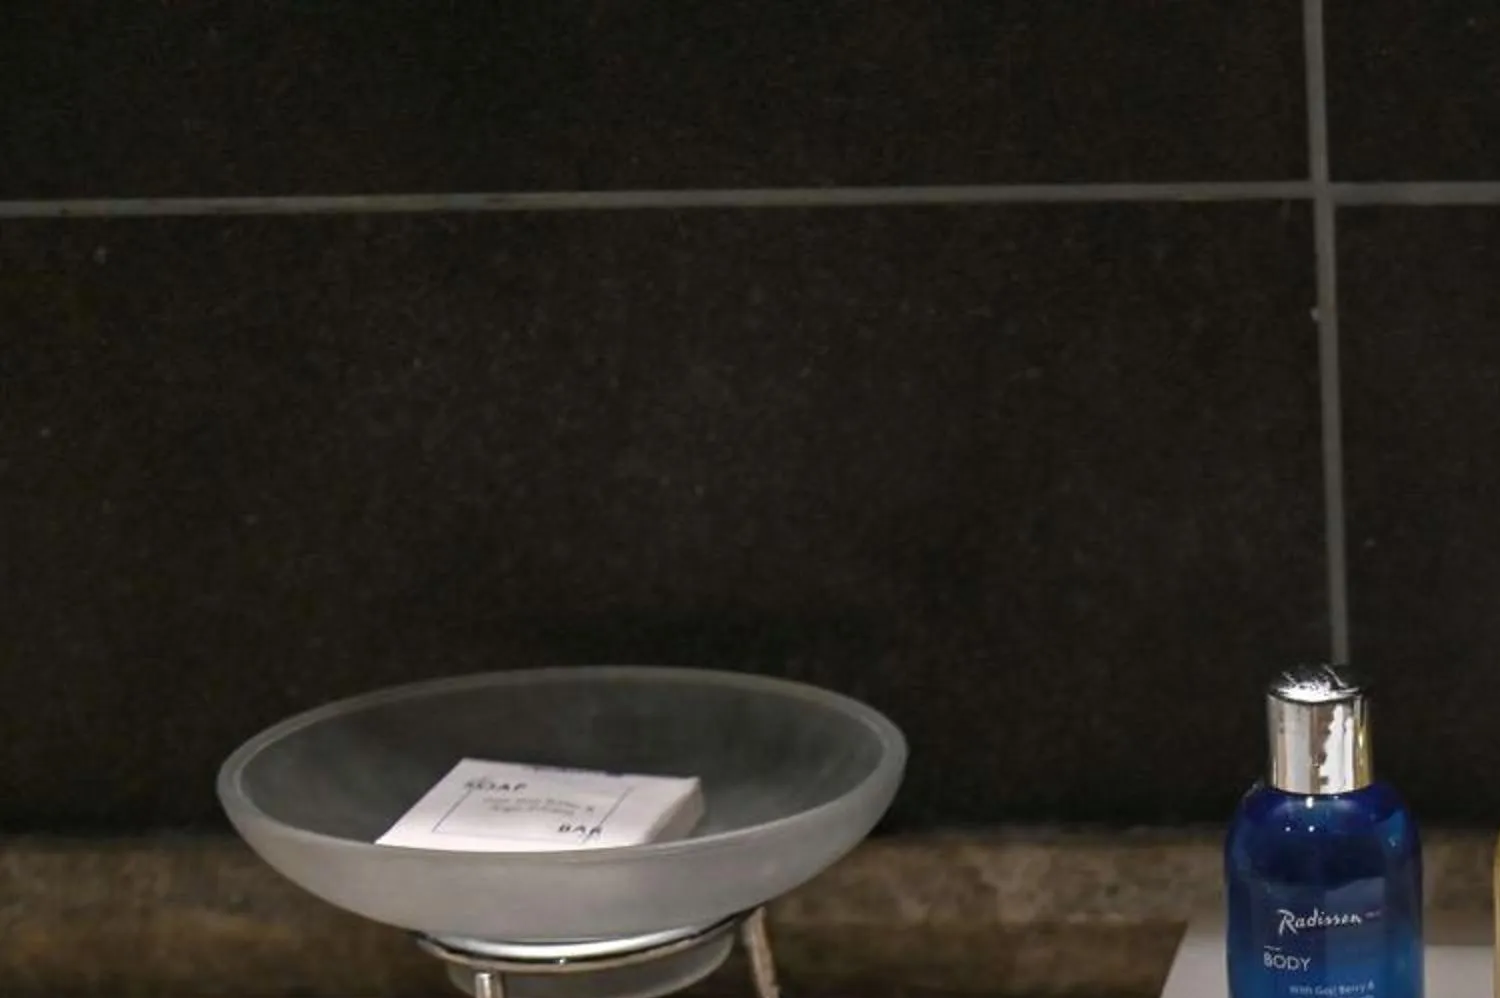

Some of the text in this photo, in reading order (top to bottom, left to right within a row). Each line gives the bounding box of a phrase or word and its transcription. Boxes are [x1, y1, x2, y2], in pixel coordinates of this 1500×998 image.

[1277, 906, 1362, 936] Radisson
[1263, 952, 1311, 971] BODY
[1289, 985, 1312, 995] With
